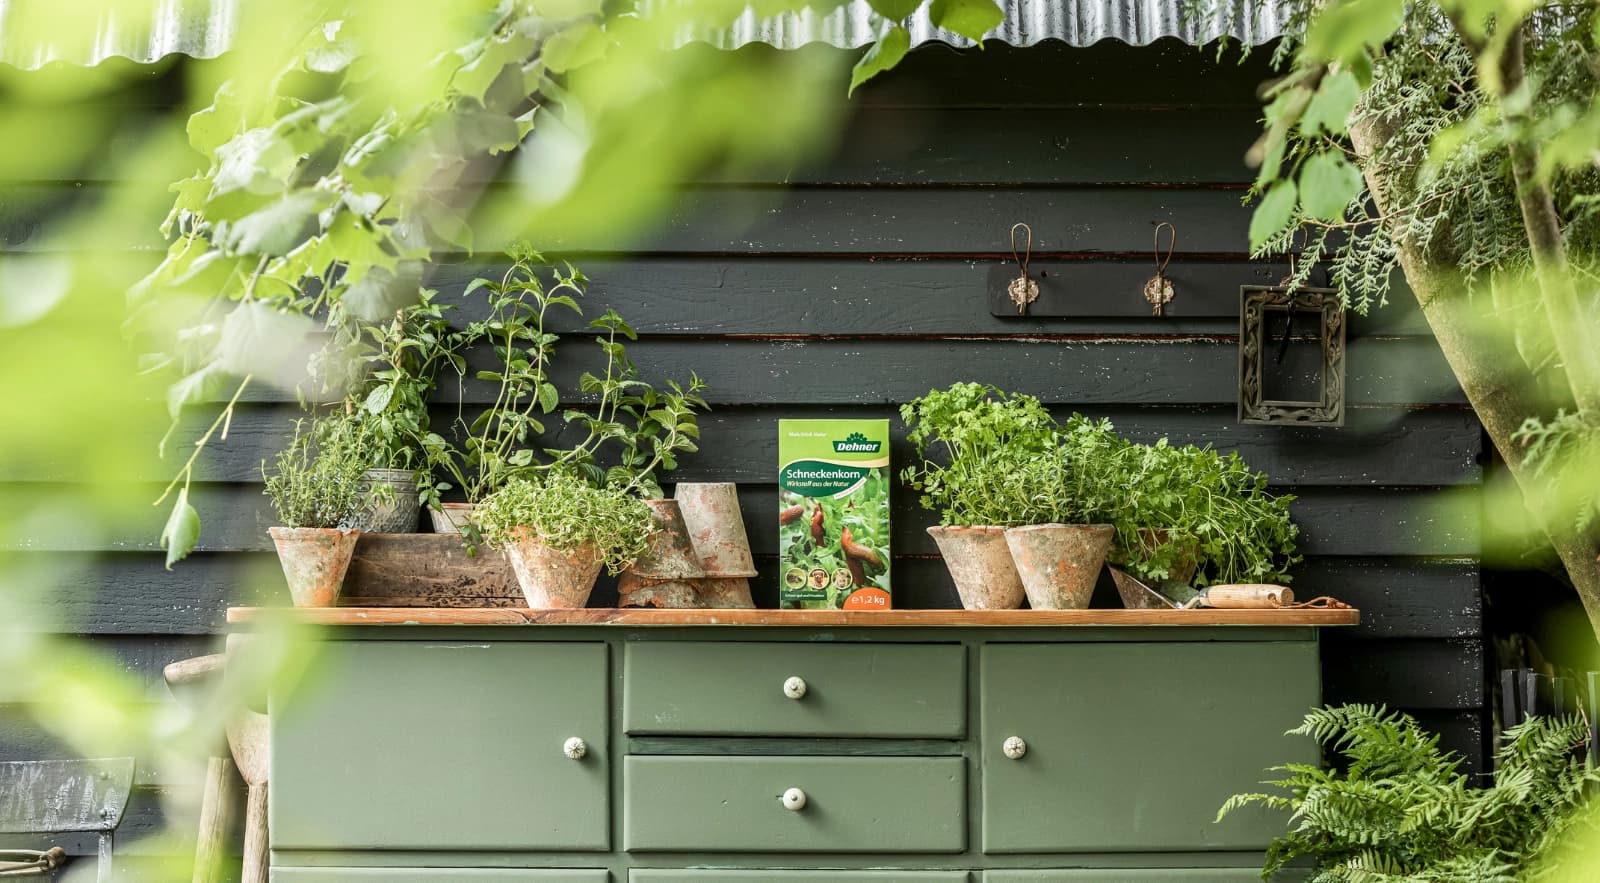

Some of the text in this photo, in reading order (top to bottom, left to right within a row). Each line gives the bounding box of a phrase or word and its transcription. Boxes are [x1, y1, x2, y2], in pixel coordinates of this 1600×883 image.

[837, 442, 878, 451] Dehner
[787, 469, 860, 479] Schneckenkorn
[874, 595, 885, 606] kg
